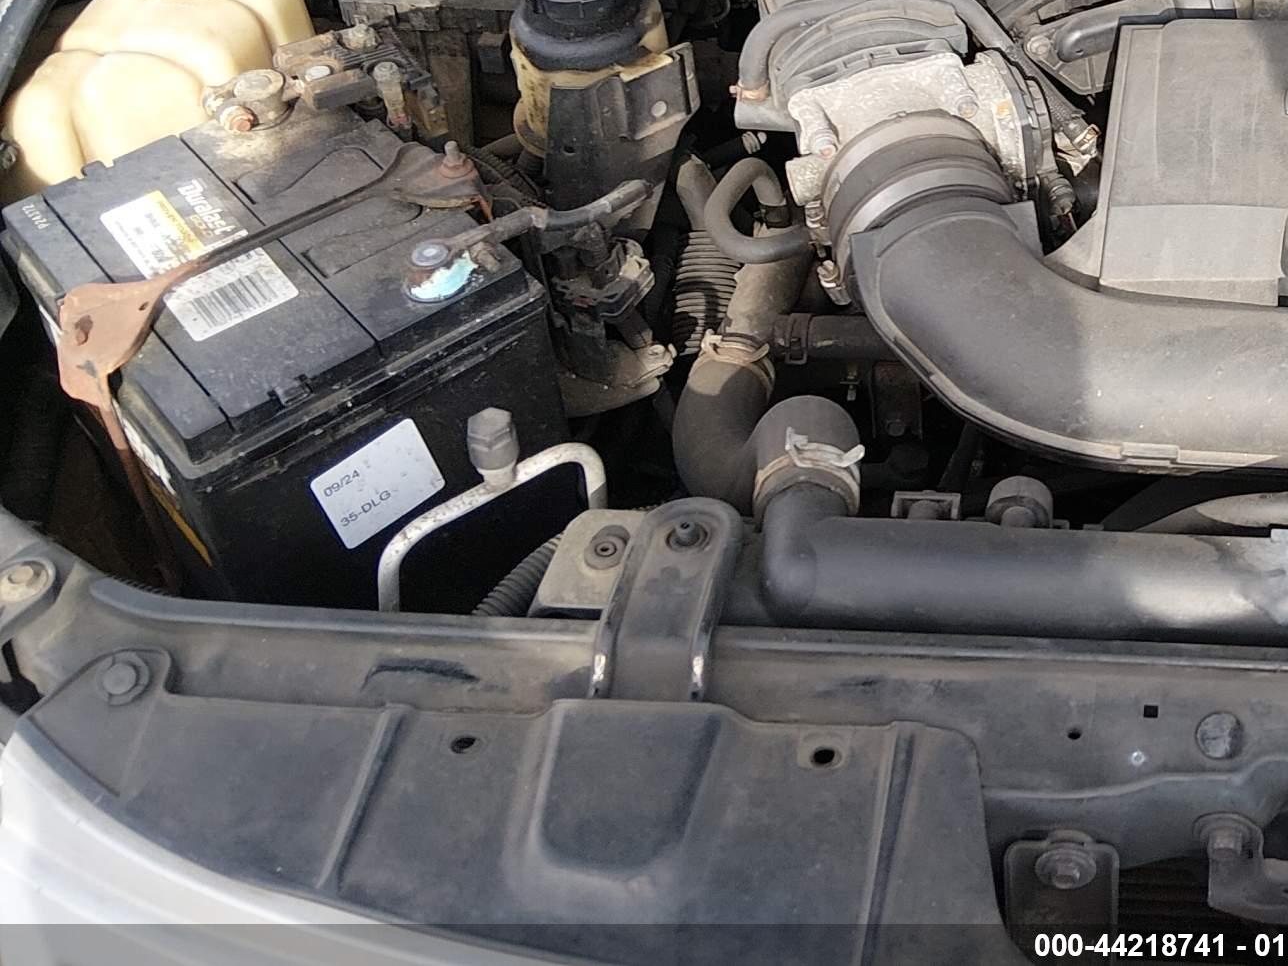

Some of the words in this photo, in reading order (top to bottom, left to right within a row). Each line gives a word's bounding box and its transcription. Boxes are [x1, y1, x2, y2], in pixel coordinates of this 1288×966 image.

[177, 178, 236, 236] Duralast
[323, 469, 360, 498] 09/24
[340, 489, 392, 527] 35-DLG
